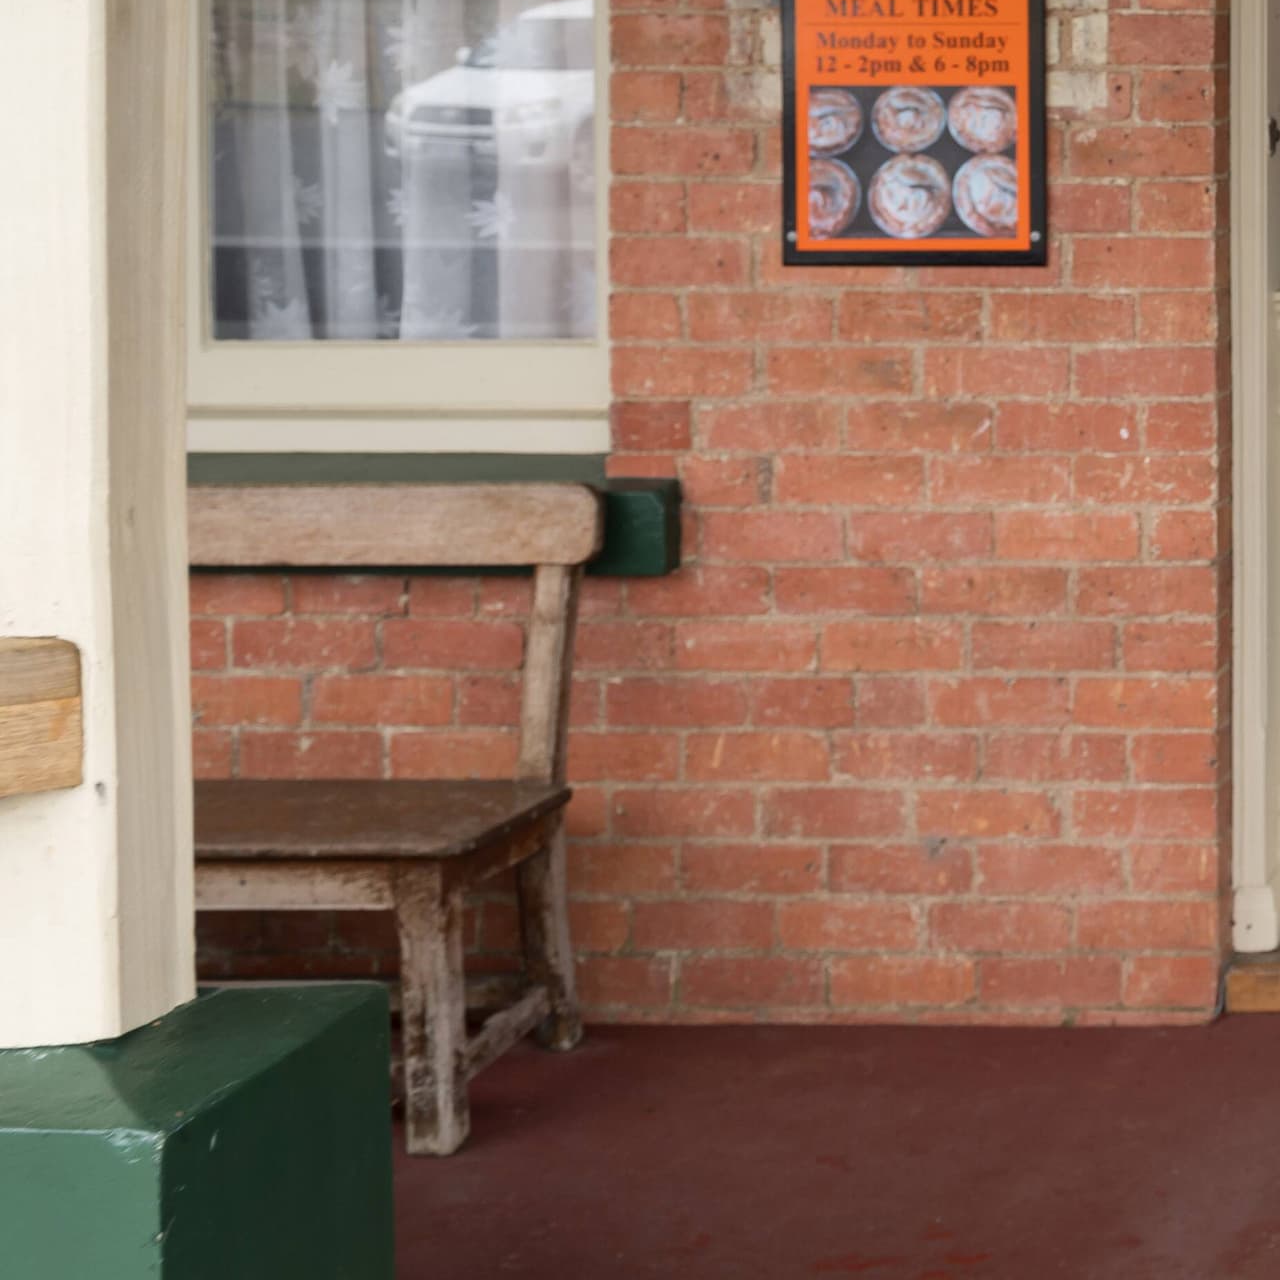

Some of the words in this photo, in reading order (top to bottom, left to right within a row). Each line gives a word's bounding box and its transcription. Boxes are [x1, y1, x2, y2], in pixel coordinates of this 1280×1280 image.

[825, 0, 903, 17] MEAL
[913, 0, 998, 17] TIMES
[816, 32, 897, 53] Monday
[907, 34, 926, 48] to
[932, 32, 1007, 53] Sunday
[816, 56, 837, 72] 12
[859, 56, 901, 77] 2pm
[909, 56, 926, 72] &
[934, 56, 946, 72] 6
[966, 56, 1010, 77] 8pm
